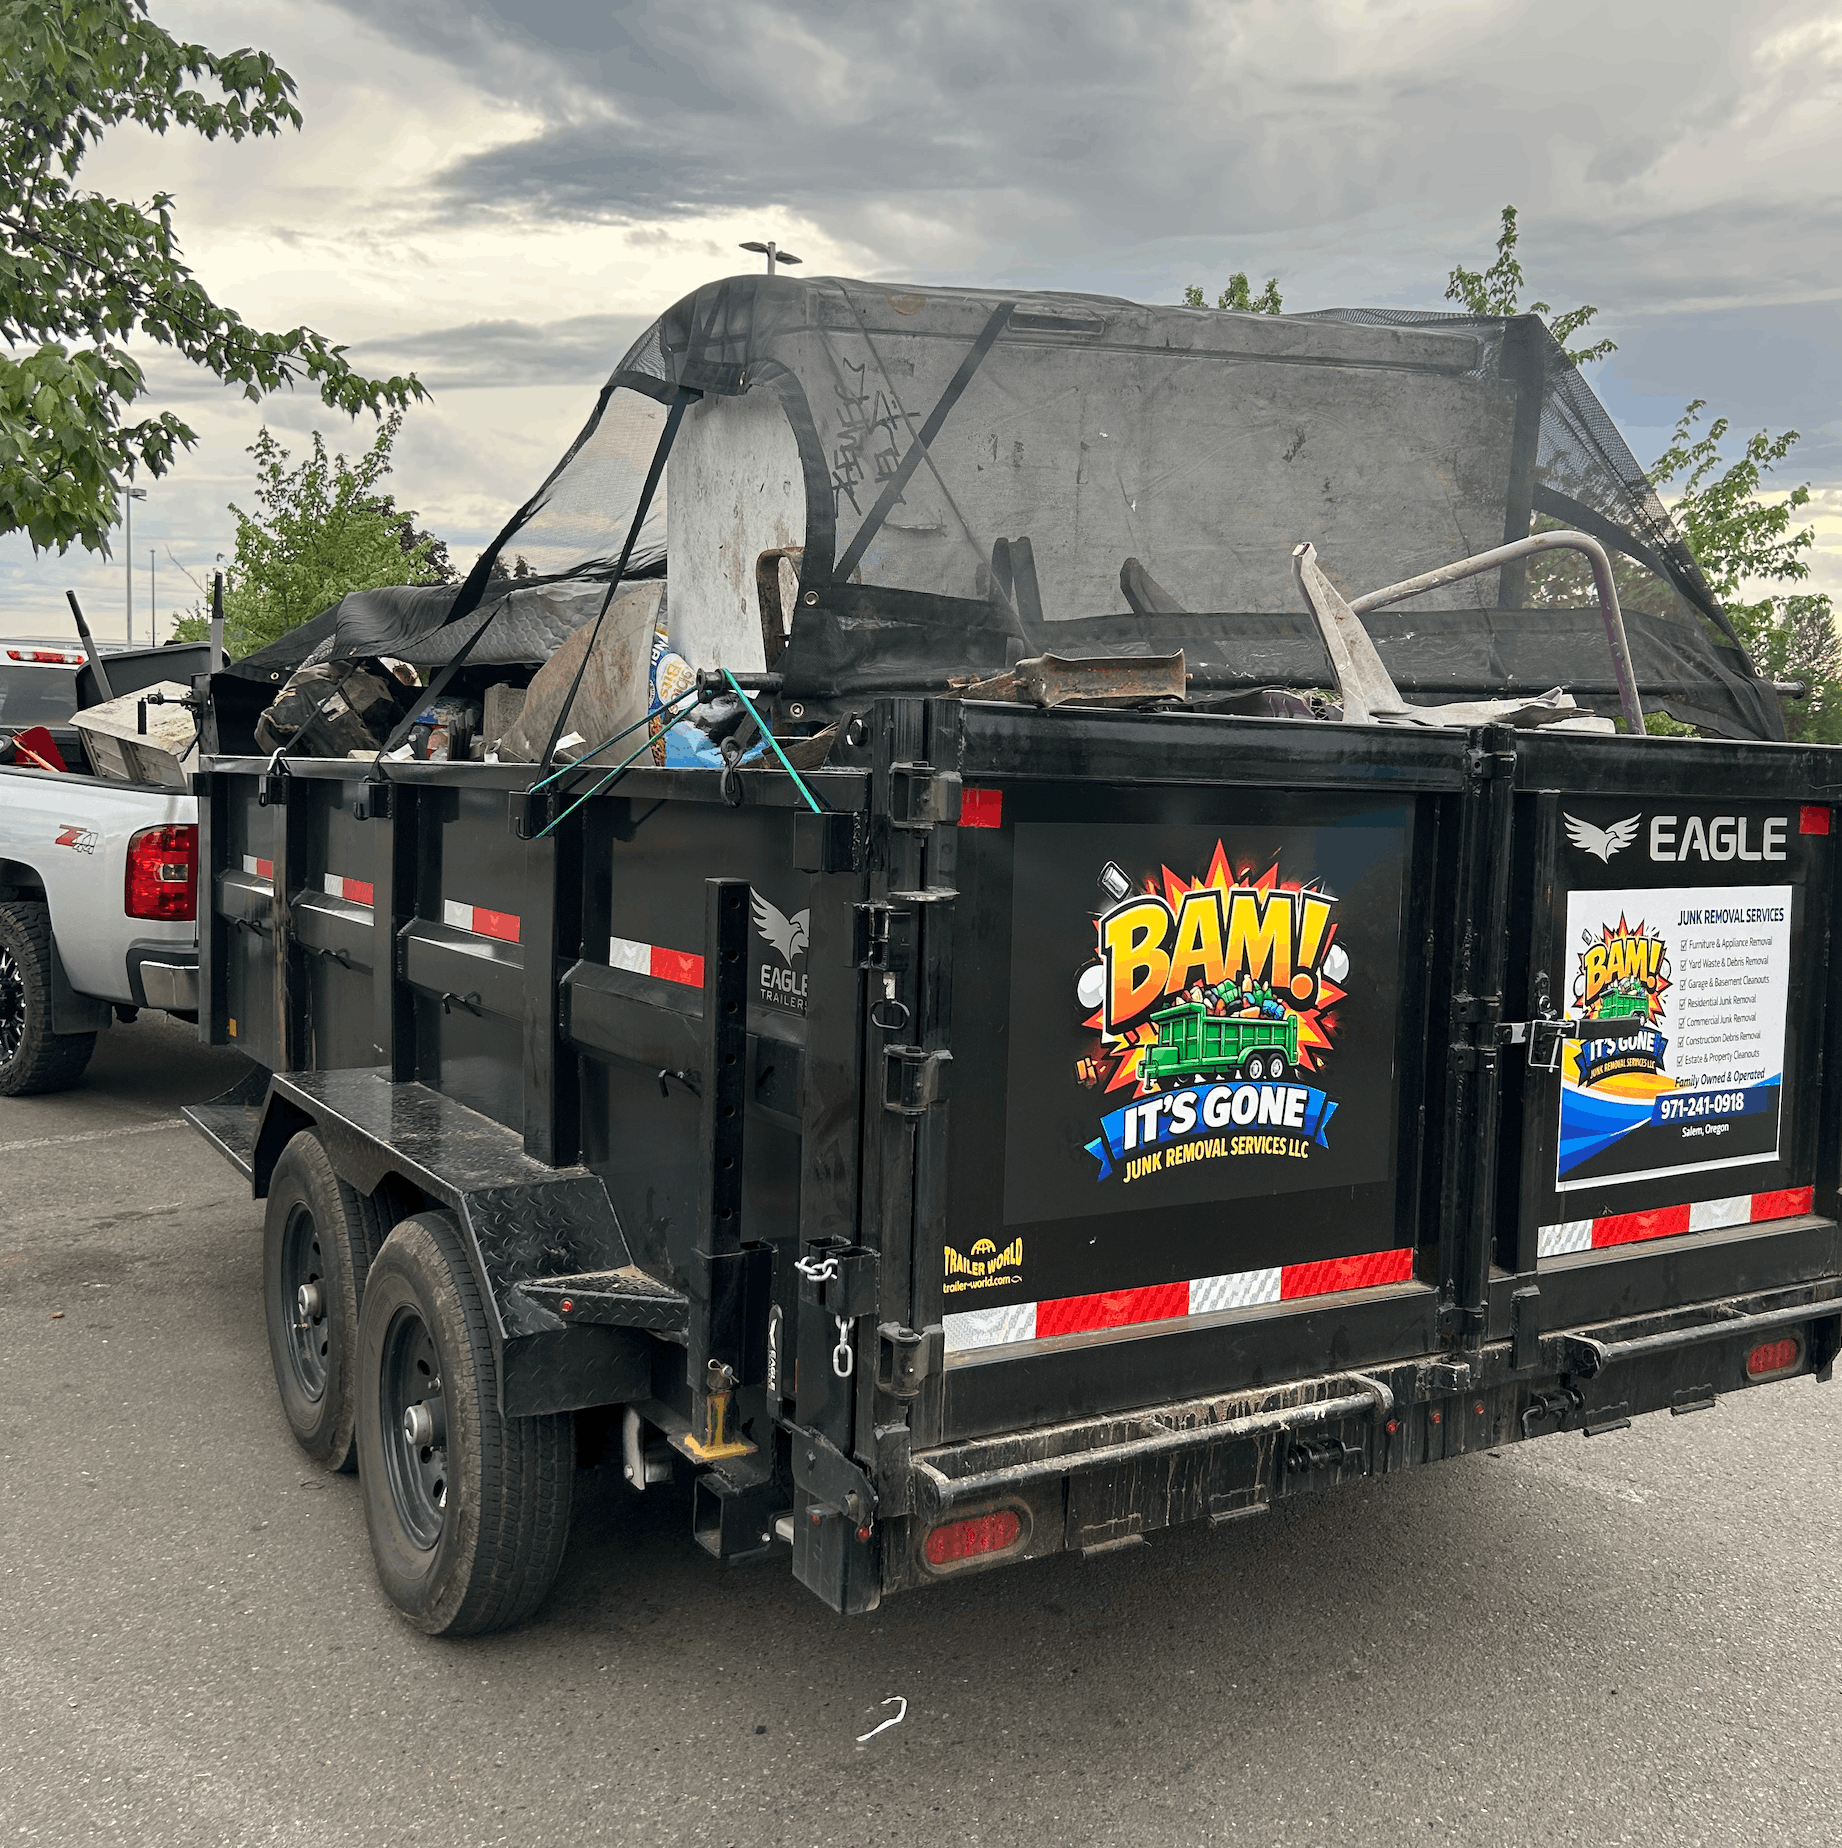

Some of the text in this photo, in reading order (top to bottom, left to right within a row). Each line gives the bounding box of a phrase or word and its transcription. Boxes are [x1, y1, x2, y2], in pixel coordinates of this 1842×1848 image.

[55, 824, 98, 847] Z71
[1650, 815, 1788, 861] EAGLE
[1677, 907, 1784, 926] JUNK REMOVAL SERVICES
[1688, 939, 1715, 950] Furniture
[1722, 938, 1748, 950] Appliance
[1749, 936, 1773, 947] Removal
[1104, 896, 1332, 1026] BAM!
[1584, 938, 1663, 1002] BAM!
[1688, 957, 1701, 969] Yard
[1703, 957, 1720, 968] Waste
[1727, 957, 1744, 967] Debris
[1745, 955, 1769, 966] Removal
[1687, 979, 1708, 991] Garage
[1714, 977, 1742, 987] Basement
[1743, 975, 1770, 985] Cleanouts
[760, 988, 808, 1011] TRAILER
[1687, 994, 1757, 1008] Residential Junk Removal
[1686, 1012, 1756, 1027] Commercial Junk Removal
[1685, 1030, 1761, 1046] Construction Debris Removal
[1684, 1055, 1702, 1065] Estate
[1709, 1052, 1732, 1063] Property
[1733, 1049, 1760, 1060] Cleanouts
[1674, 1075, 1699, 1088] Family
[1701, 1072, 1726, 1085] Owned
[1733, 1068, 1766, 1084] Operated
[1661, 1092, 1744, 1119] 971-241-0918
[1123, 1085, 1308, 1150] IT'S GONE
[1682, 1123, 1730, 1138] Salem, Oregon
[1123, 1136, 1309, 1183] JUNK REMOVAL SERVICES LLC
[944, 1237, 1023, 1276] TRAILER WORLD
[943, 1276, 1011, 1293] trailer-world.com
